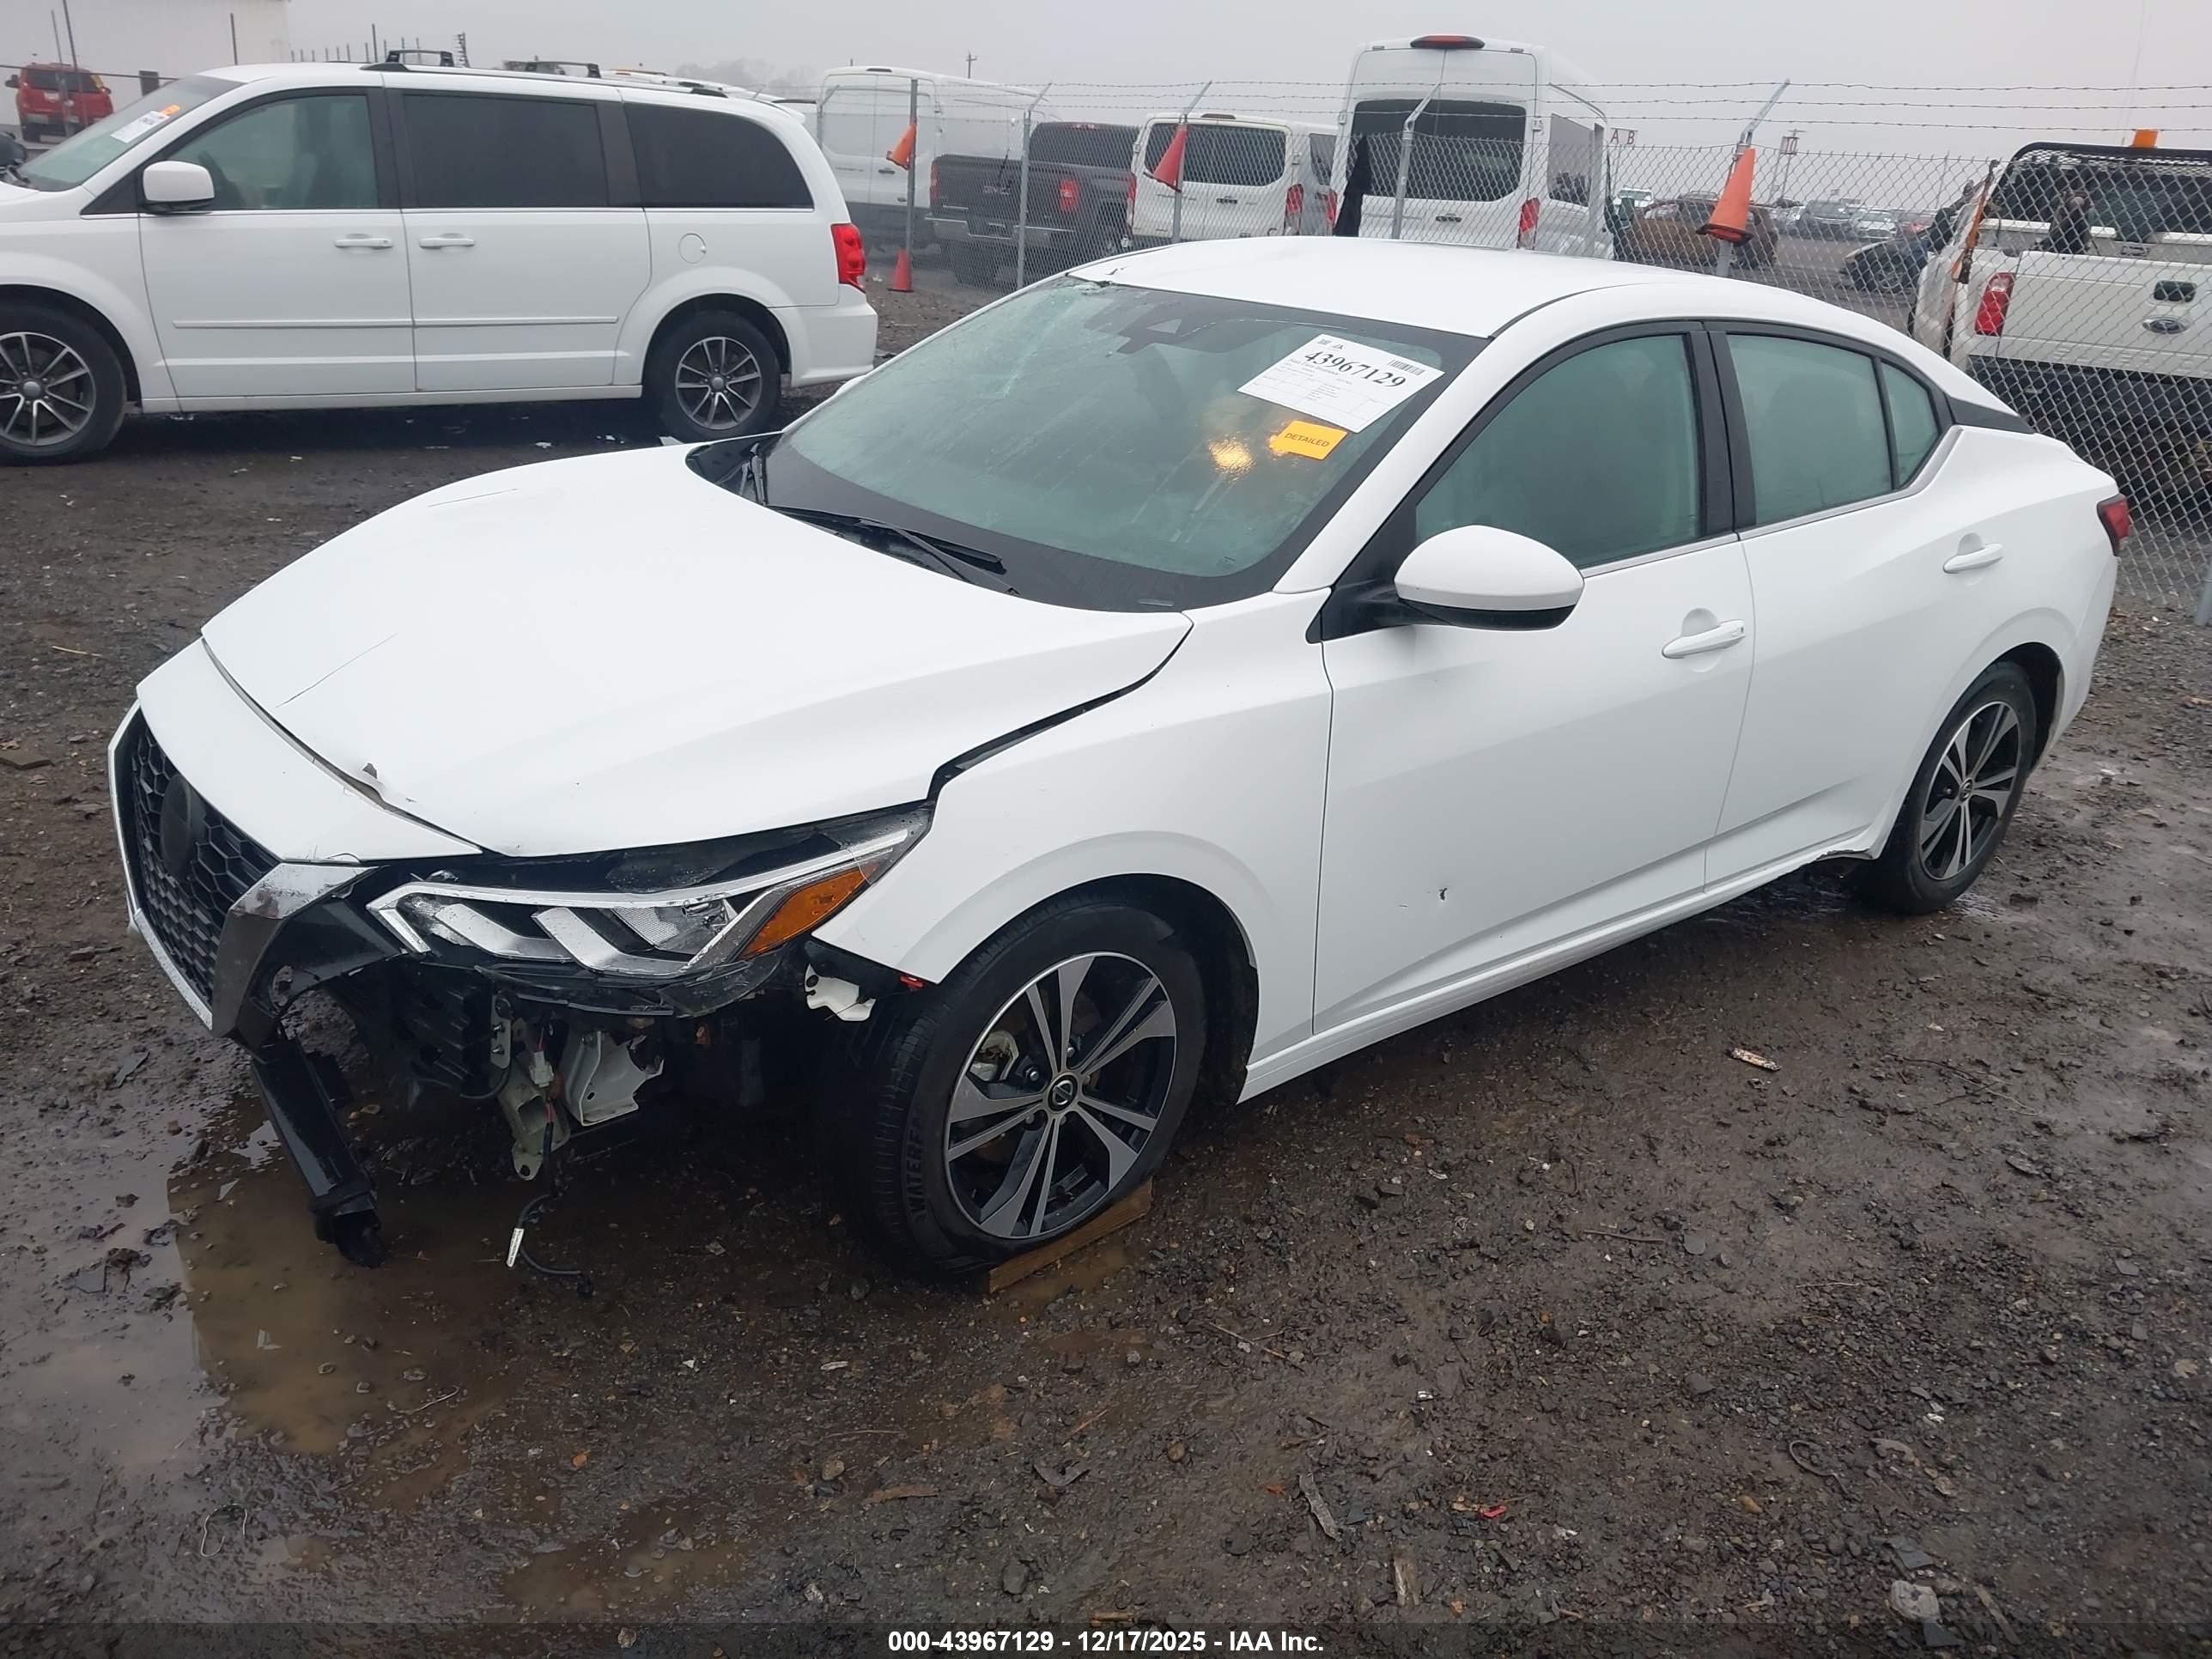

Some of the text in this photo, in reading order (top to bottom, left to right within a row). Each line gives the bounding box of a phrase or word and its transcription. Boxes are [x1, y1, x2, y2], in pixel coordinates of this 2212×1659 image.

[1610, 129, 1637, 145] A B
[1304, 350, 1407, 387] 43967129
[1284, 432, 1330, 447] DETAILED
